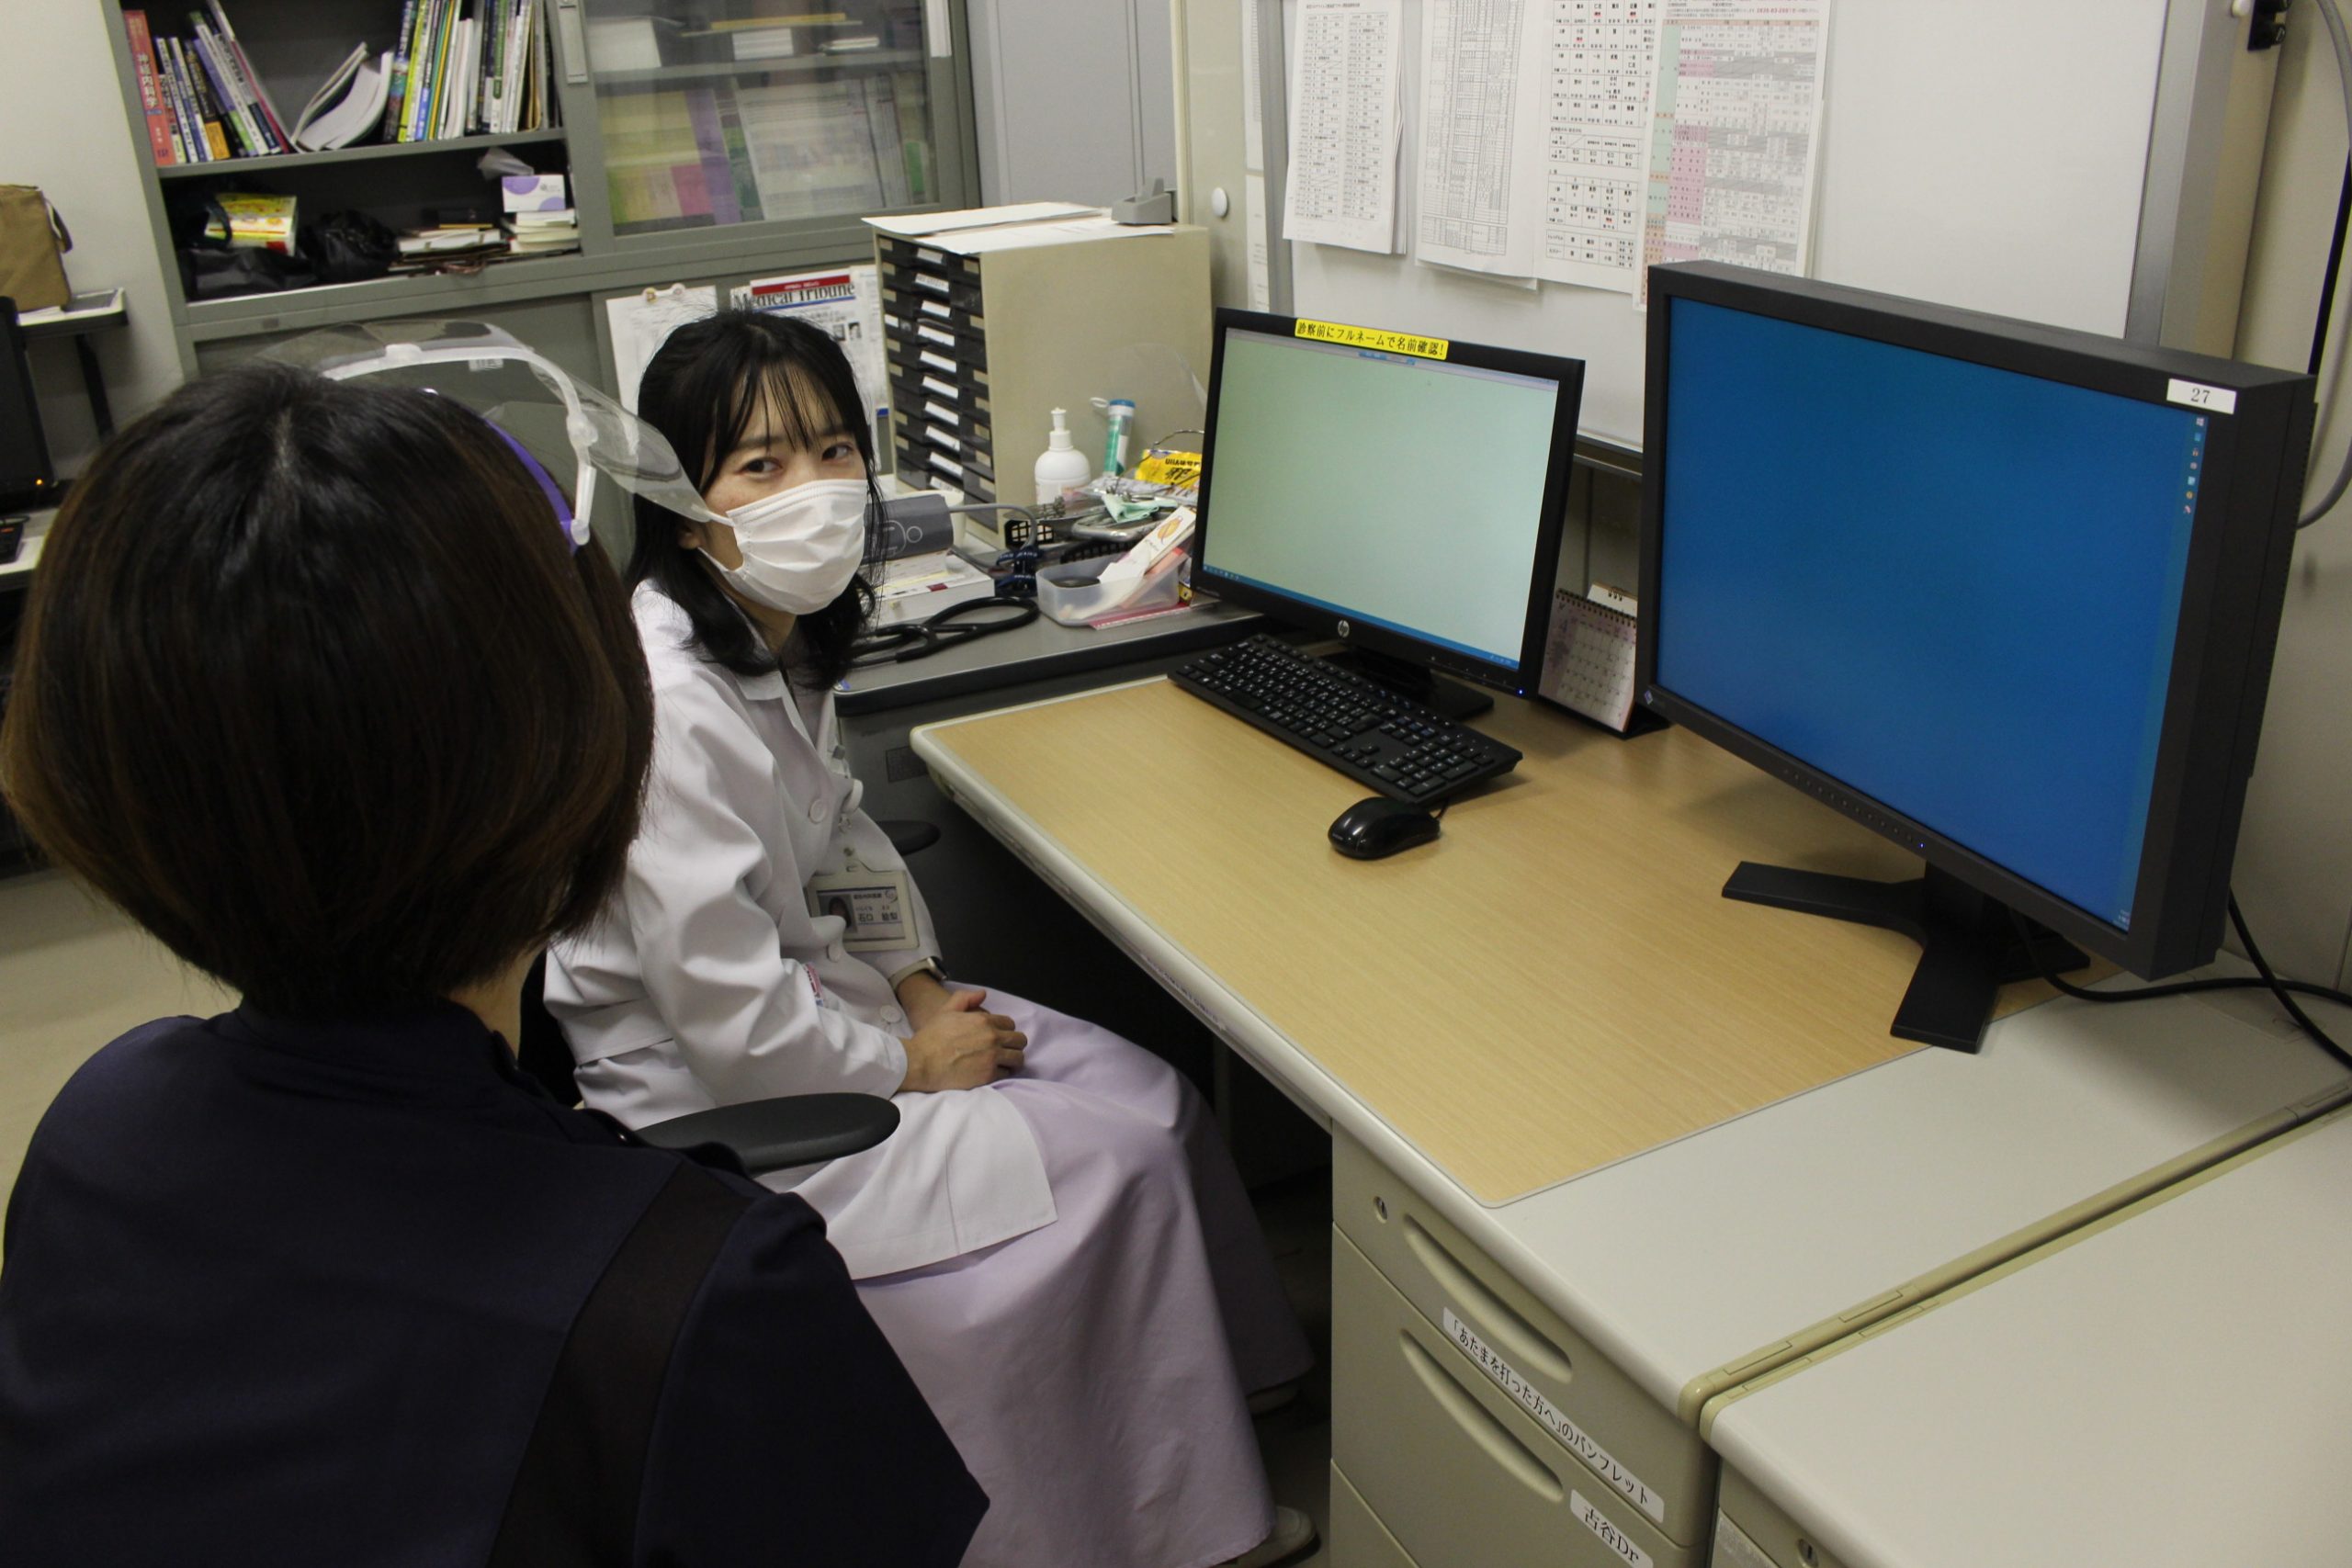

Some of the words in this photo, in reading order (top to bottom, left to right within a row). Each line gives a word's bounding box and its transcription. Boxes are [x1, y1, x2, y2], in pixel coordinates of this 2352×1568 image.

[2190, 387, 2211, 404] 27
[1453, 1318, 1649, 1506] 「あたまを打った方へ」のパンフレット
[1583, 1507, 1640, 1562] 古谷Dr
